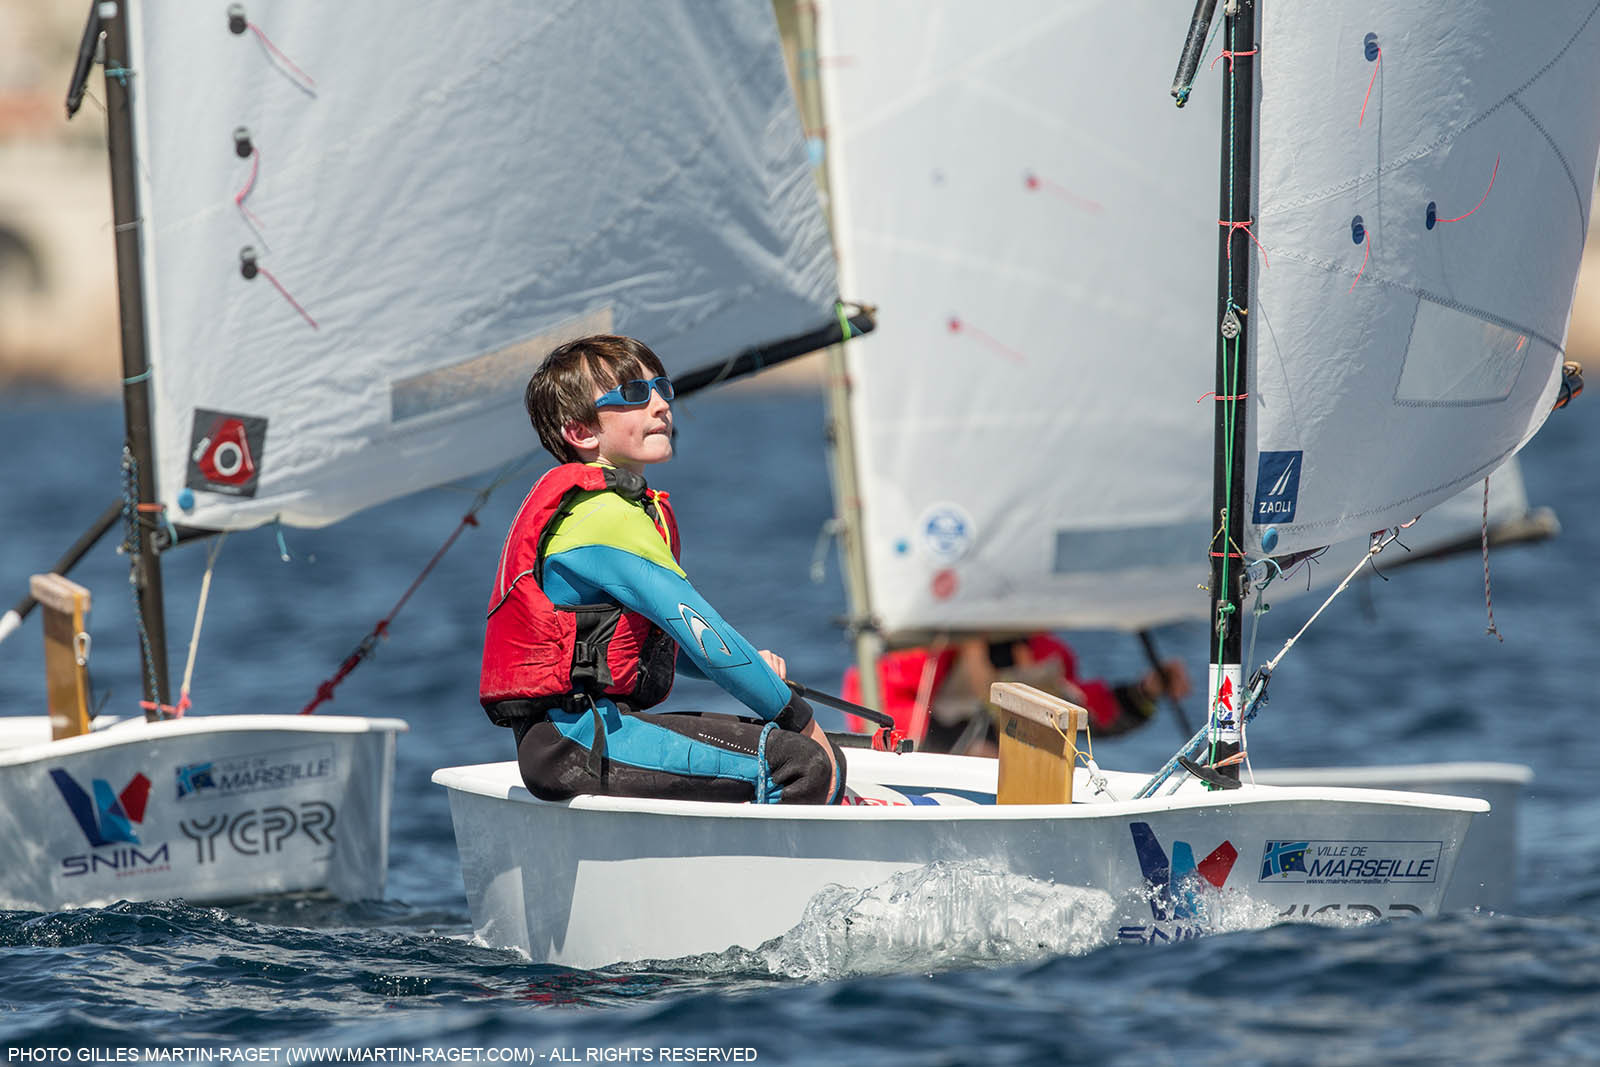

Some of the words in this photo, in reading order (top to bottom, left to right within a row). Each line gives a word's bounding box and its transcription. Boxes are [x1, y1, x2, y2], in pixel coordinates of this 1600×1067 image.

[1259, 501, 1292, 514] ZAOLI
[219, 757, 331, 790] MARSEILLE
[179, 801, 337, 865] YCPR
[62, 841, 170, 877] SNIM
[1316, 846, 1349, 857] VILLE
[1350, 846, 1368, 857] DE
[1308, 859, 1435, 877] MARSEILLE
